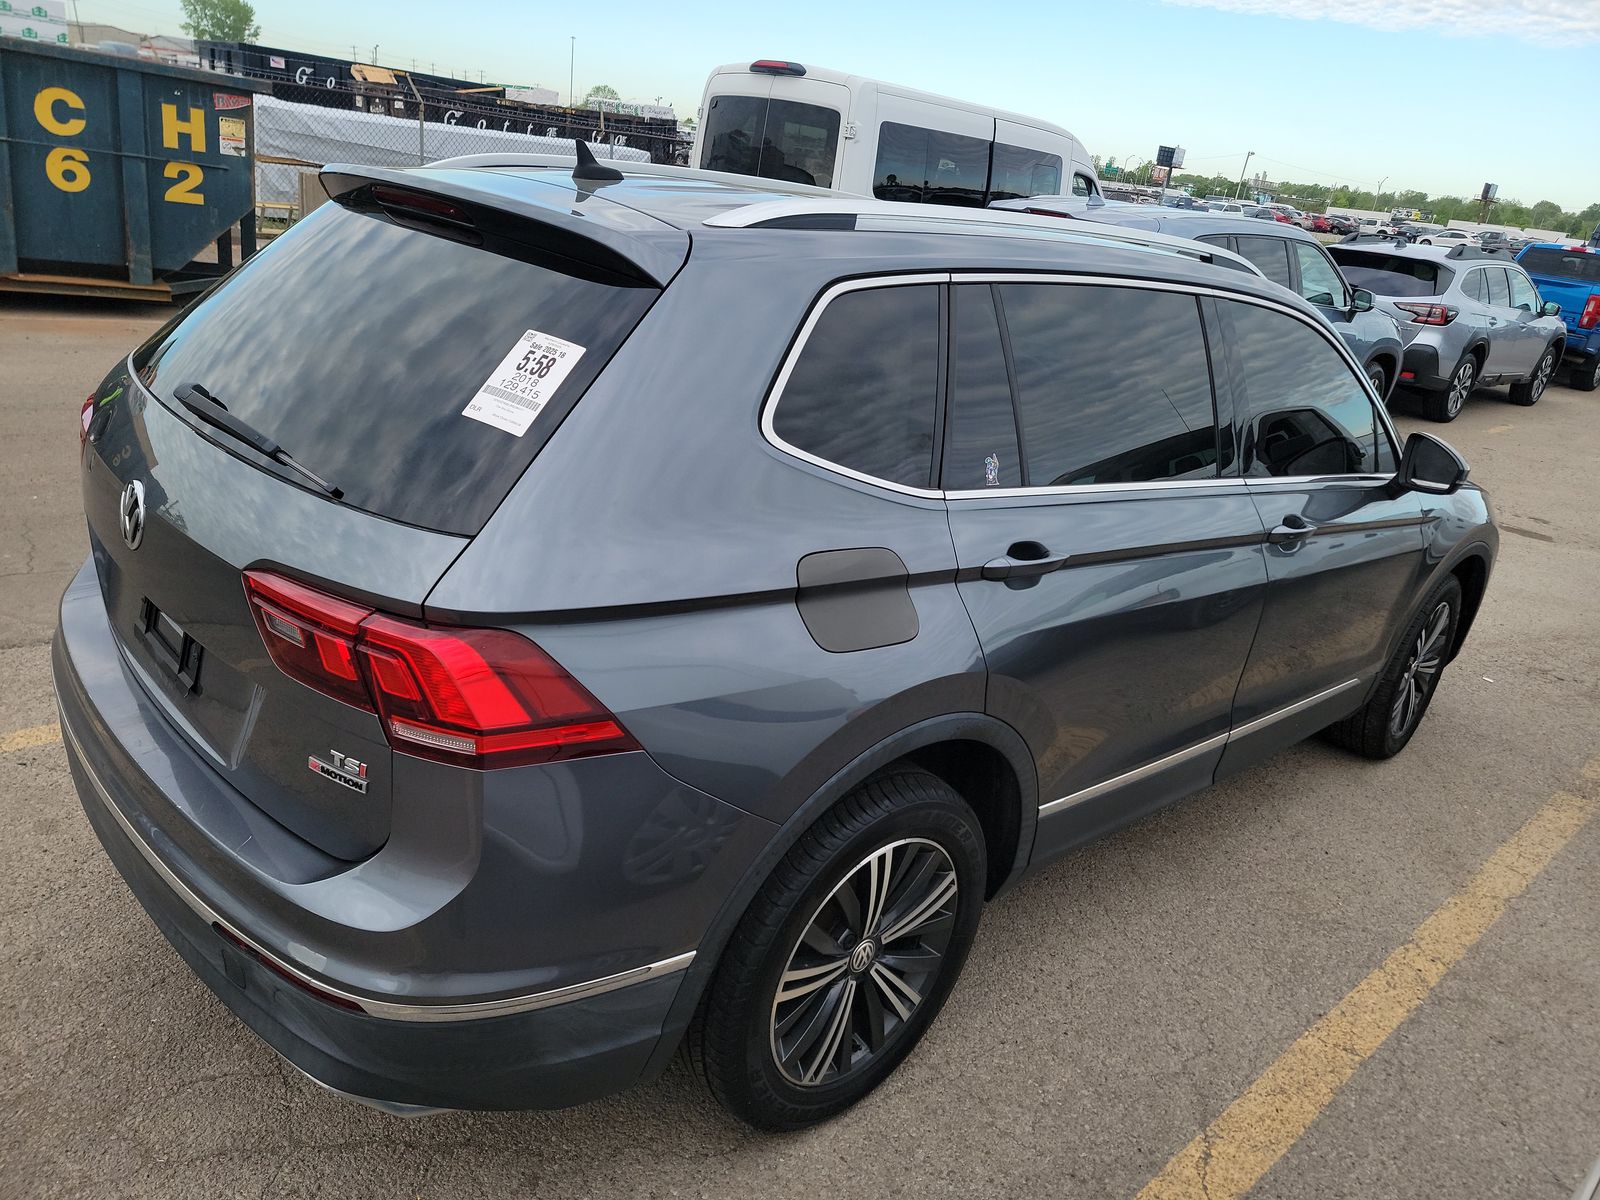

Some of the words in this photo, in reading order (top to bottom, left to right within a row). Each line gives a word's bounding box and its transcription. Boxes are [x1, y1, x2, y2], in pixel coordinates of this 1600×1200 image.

[34, 86, 86, 136] C
[161, 103, 206, 153] H
[45, 146, 91, 193] 6
[163, 161, 204, 205] 2
[530, 342, 543, 352] Sale
[543, 346, 558, 356] 2025
[516, 350, 556, 378] 5:58
[499, 379, 541, 399] 129,415
[512, 372, 540, 388] 2018
